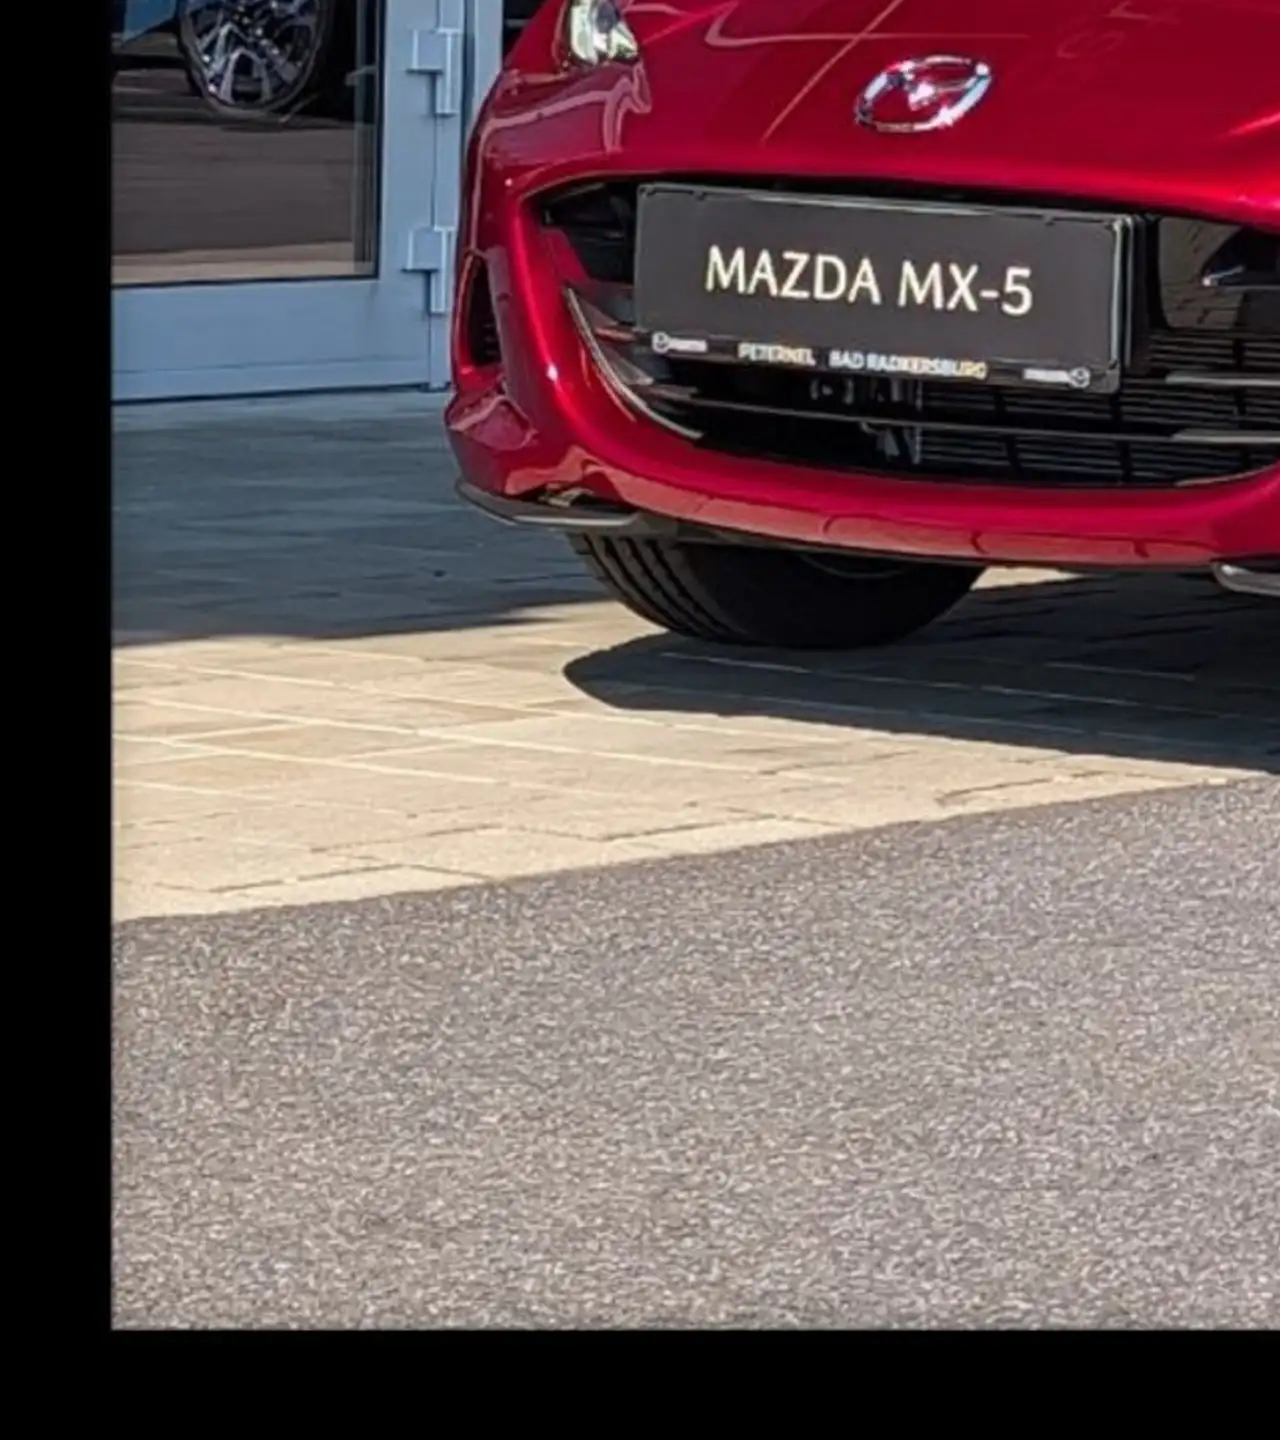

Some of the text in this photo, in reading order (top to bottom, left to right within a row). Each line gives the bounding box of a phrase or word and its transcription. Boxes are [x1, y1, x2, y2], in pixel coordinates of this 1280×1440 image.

[704, 244, 1034, 318] MAZDA MX-5
[737, 341, 816, 367] PETERNEL
[828, 348, 866, 370] BAD
